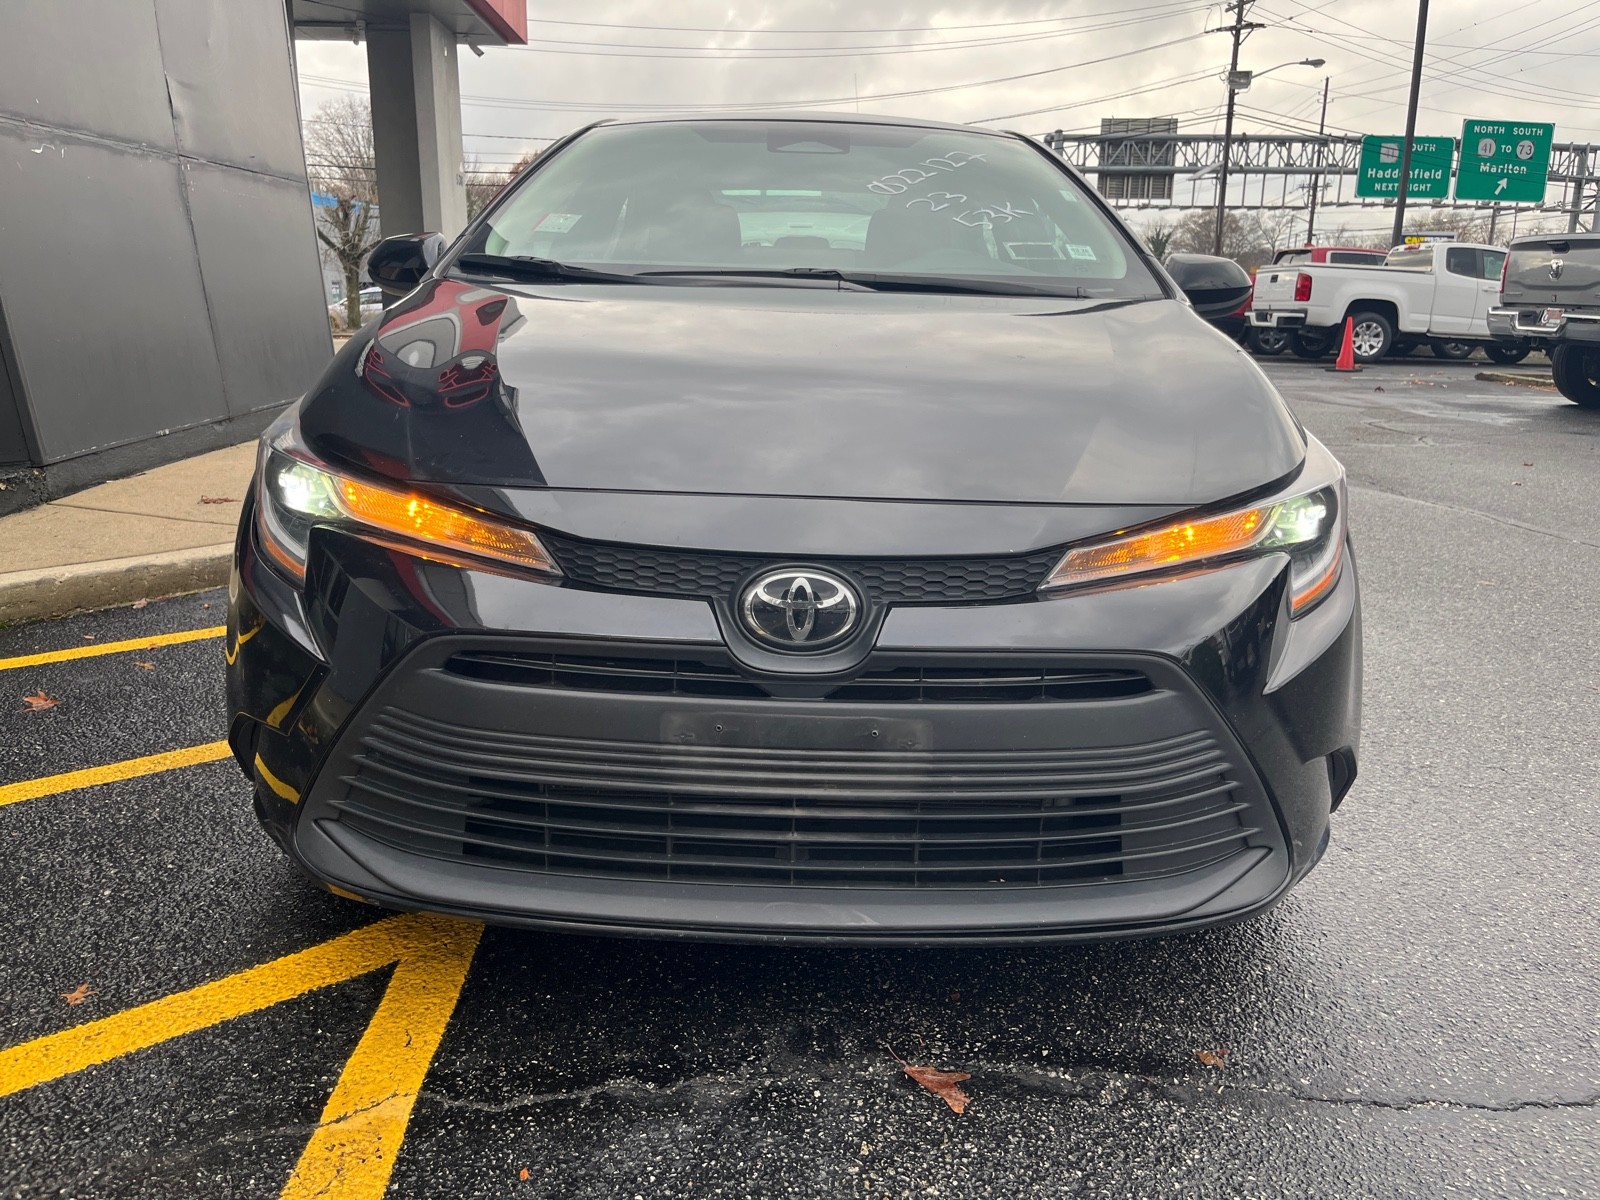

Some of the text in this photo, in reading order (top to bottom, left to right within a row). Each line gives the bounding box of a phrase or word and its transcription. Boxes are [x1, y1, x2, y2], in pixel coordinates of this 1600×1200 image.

[1474, 125, 1543, 136] NORTH SOUTH
[1412, 143, 1436, 152] OUTH
[1481, 143, 1532, 155] 41 TO 73
[1367, 168, 1442, 179] Haddnfield
[1480, 162, 1527, 174] Marlton
[1374, 183, 1432, 192] NEXT IGHT
[906, 191, 967, 212] 23
[952, 202, 1034, 230] 53K
